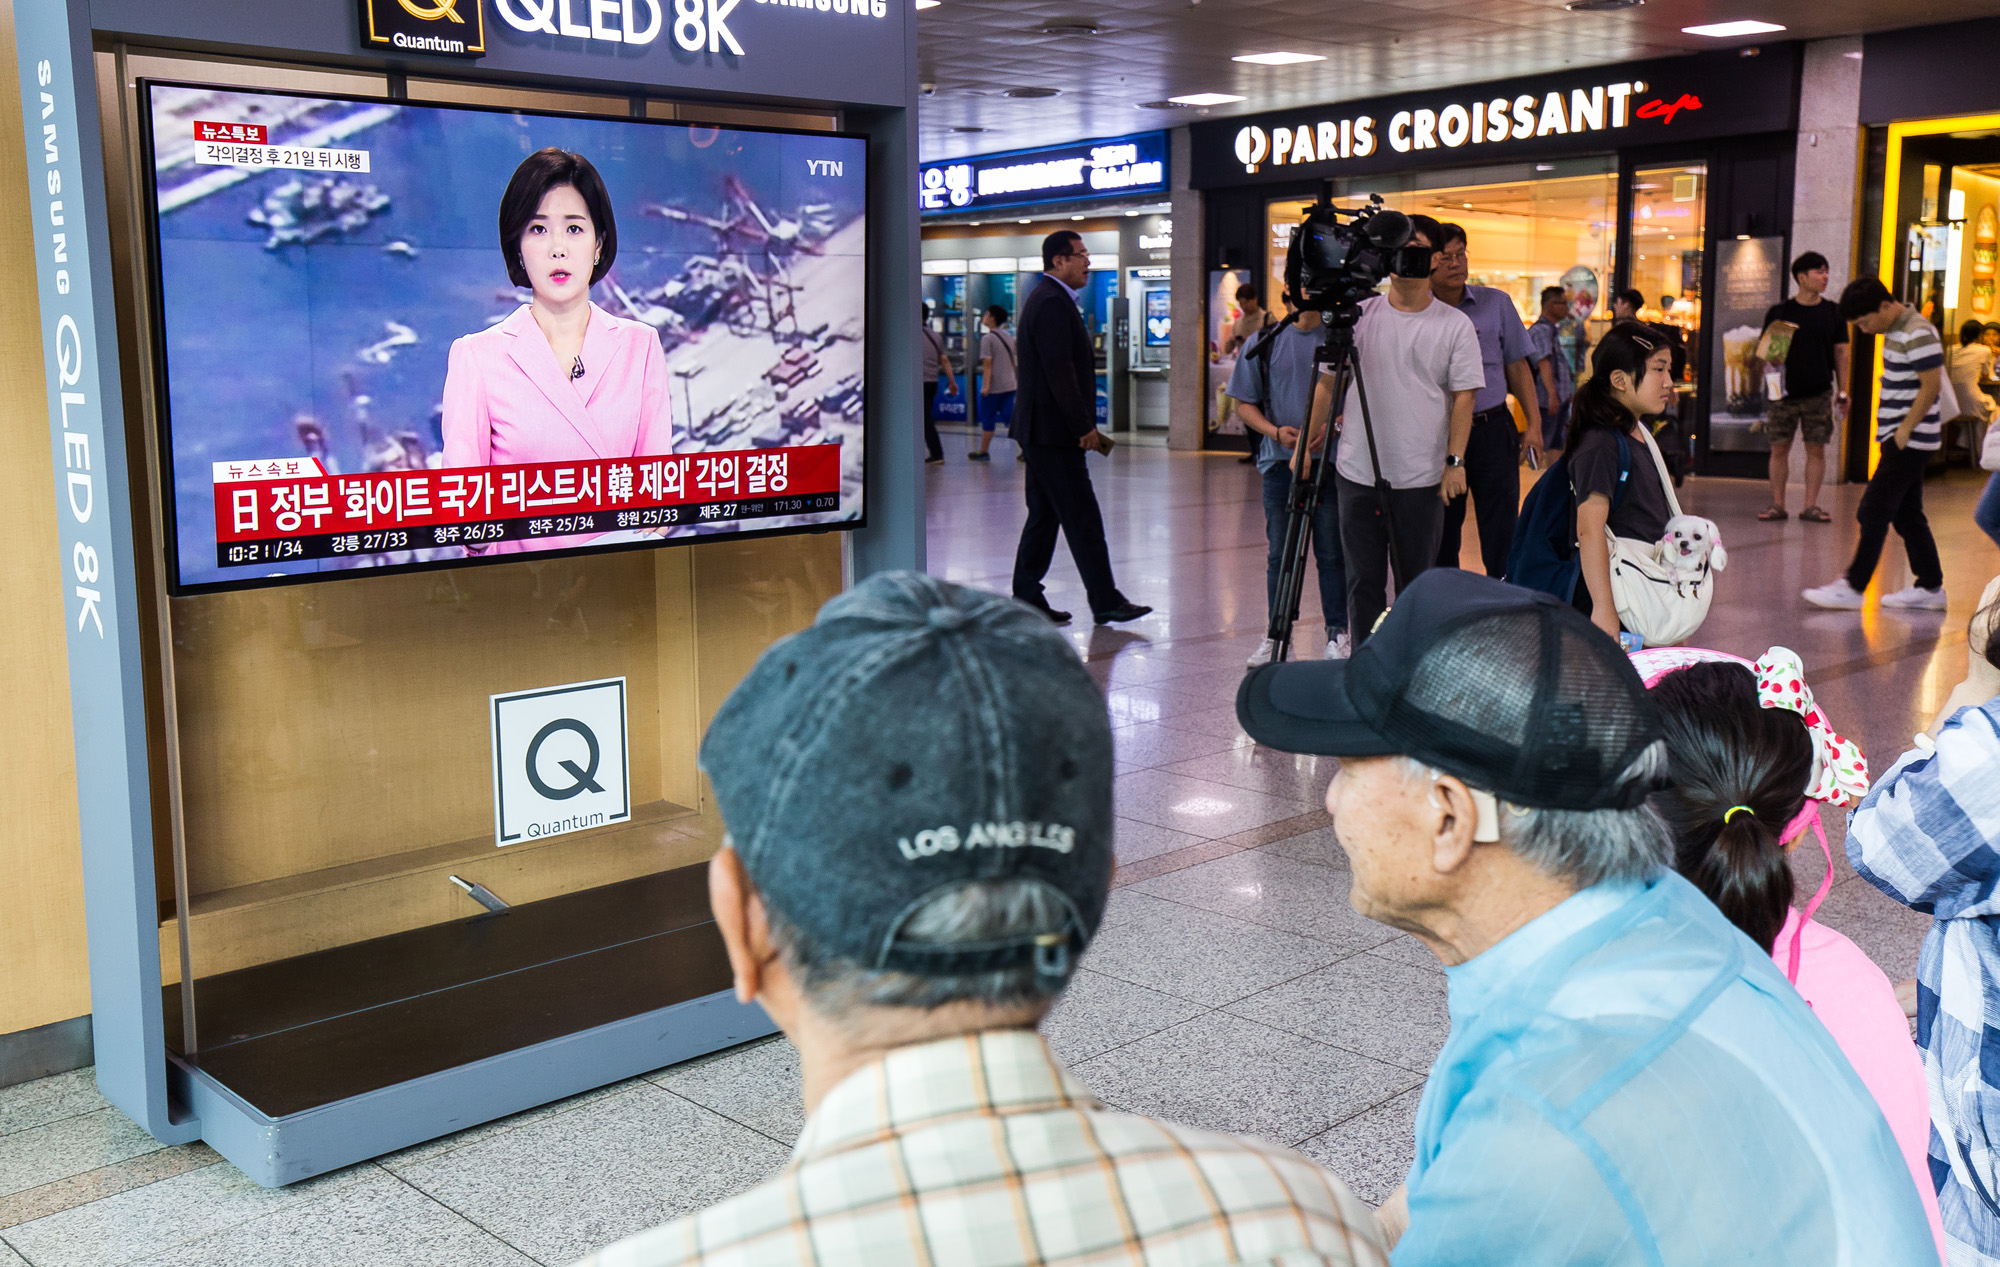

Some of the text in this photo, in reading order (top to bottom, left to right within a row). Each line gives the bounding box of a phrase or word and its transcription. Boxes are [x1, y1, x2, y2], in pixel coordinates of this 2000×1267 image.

[496, 0, 661, 45] QLED
[674, 0, 745, 56] 8K
[393, 32, 464, 53] Quantum
[201, 123, 261, 142] 뉴스특보
[1272, 115, 1376, 166] PARIS
[1388, 80, 1632, 154] CROISSANT
[207, 144, 361, 170] 각의결정 후 21일 뒤 시행
[806, 159, 843, 177] YTN
[919, 164, 974, 209] 은행
[37, 58, 104, 640] SAMSUNG QLED 8K
[227, 460, 301, 480] 뉴스속보
[232, 452, 789, 534] 日 정부 '화이트 국가 리스트서 韓 제외' 각의 결정
[773, 499, 802, 511] 171.30
[815, 496, 834, 508] 0.70
[616, 508, 679, 527] 창원 25/33
[699, 503, 738, 519] 제주 27
[433, 523, 504, 544] 청주 26/35
[528, 515, 595, 535] 전주 25/34
[331, 531, 408, 553] 강릉 27/33
[228, 544, 269, 562] 10:21
[527, 811, 605, 838] Quantum
[898, 825, 961, 860] LOS
